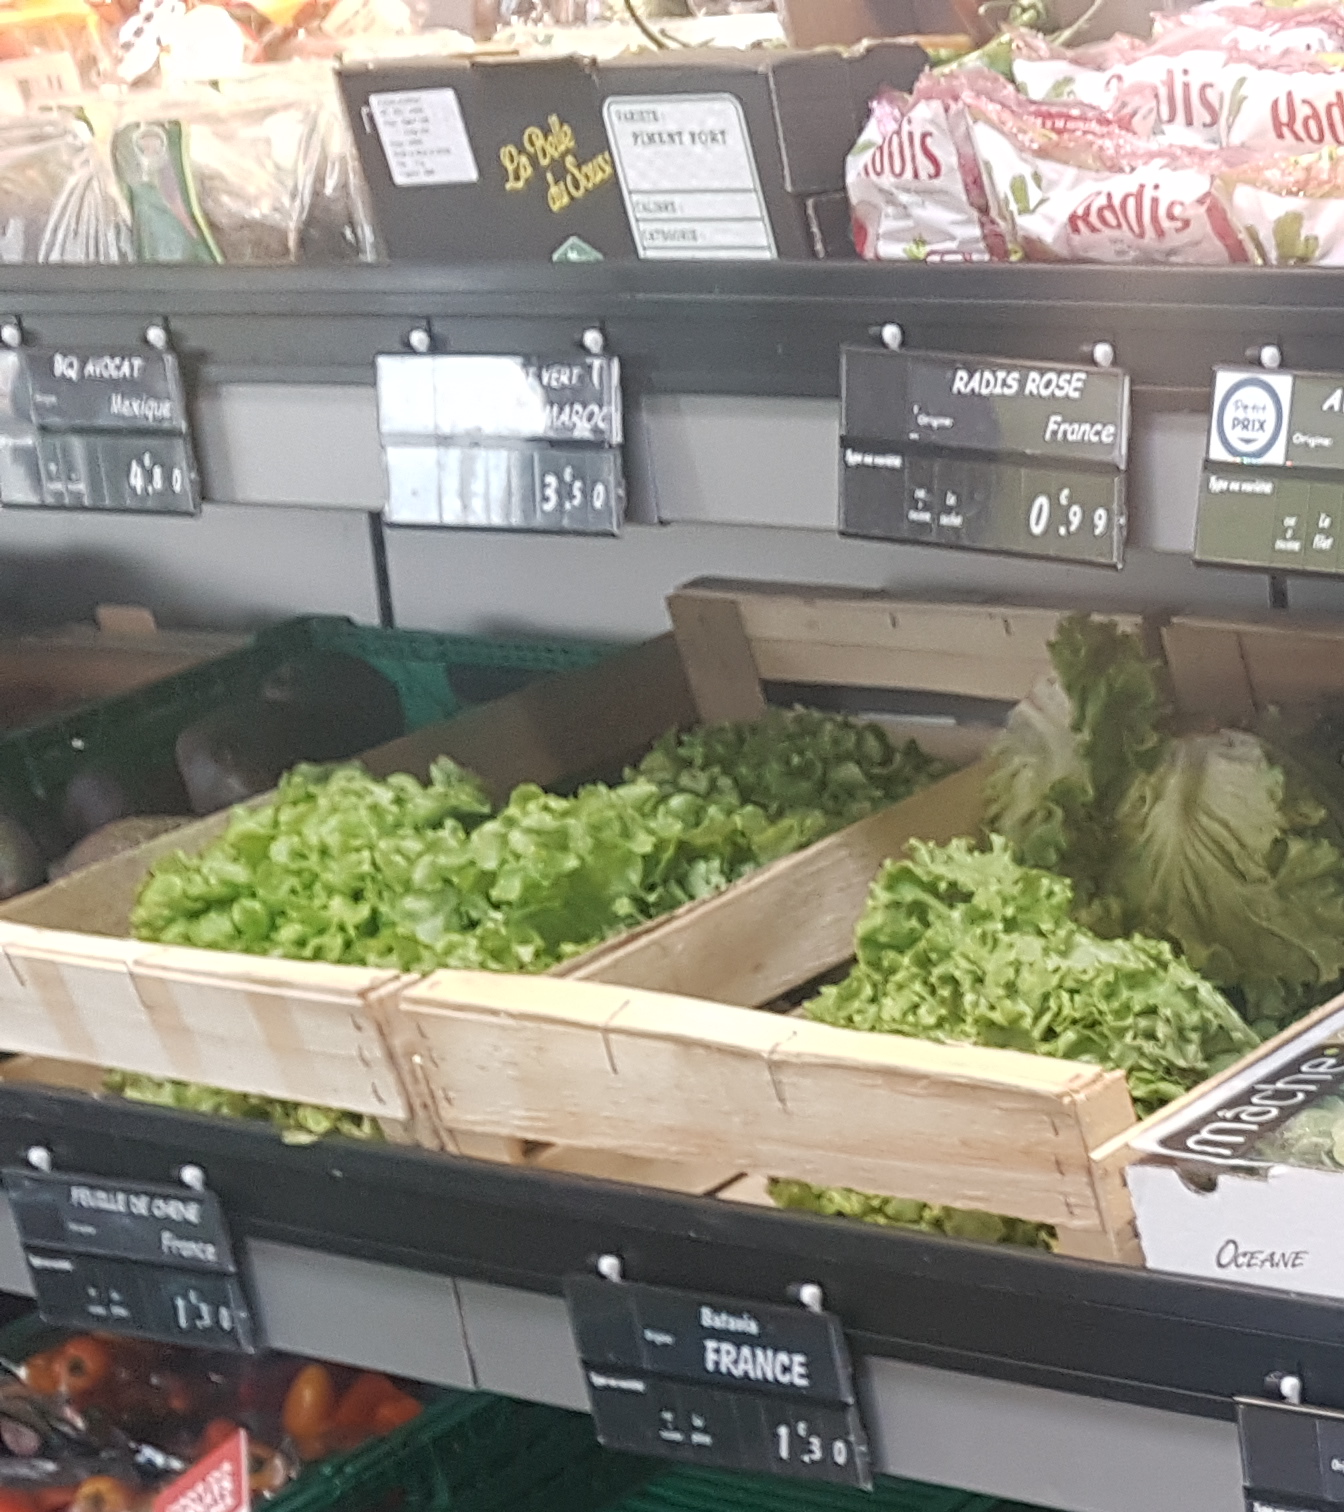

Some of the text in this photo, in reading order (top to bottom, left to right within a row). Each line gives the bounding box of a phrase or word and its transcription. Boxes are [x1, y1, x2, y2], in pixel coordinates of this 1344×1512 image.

[951, 368, 1087, 399] RADIS ROSE
[1043, 414, 1117, 444] France
[1231, 416, 1267, 434] PRIX
[700, 1305, 760, 1337] Batavia
[702, 1338, 811, 1388] FRANCE
